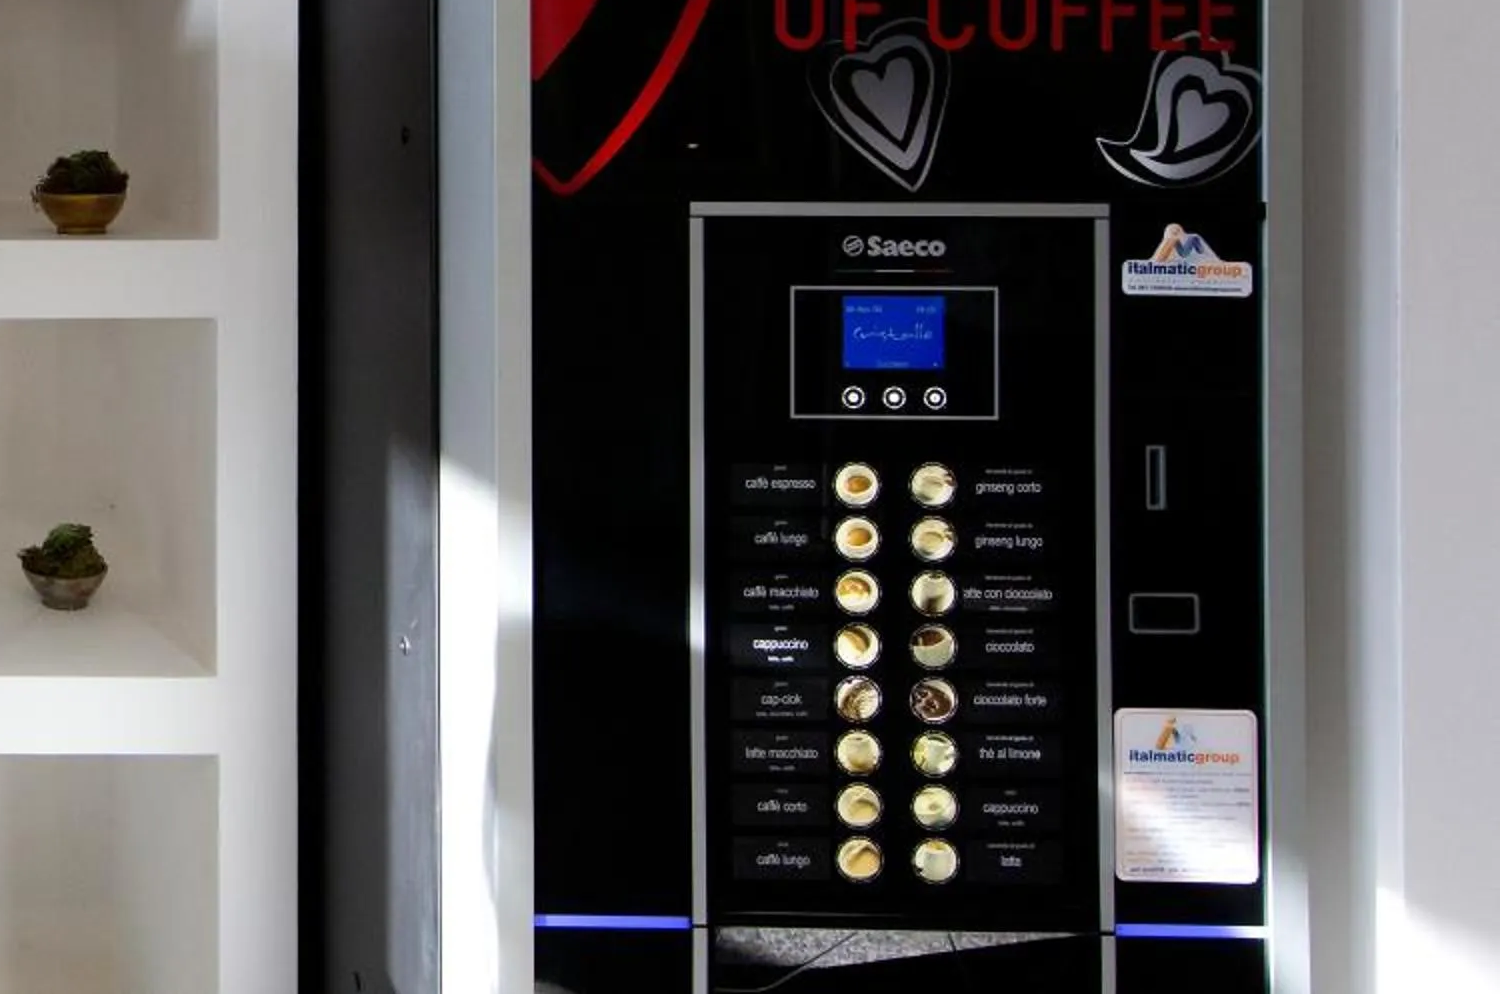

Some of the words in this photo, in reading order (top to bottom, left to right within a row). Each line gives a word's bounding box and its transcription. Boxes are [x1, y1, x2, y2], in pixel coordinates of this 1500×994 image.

[867, 235, 947, 257] Saeco
[1127, 261, 1242, 279] italmaticgroup
[745, 476, 769, 489] caffè
[771, 479, 816, 491] espresso
[975, 481, 1015, 495] ginseng
[1016, 481, 1043, 493] corto
[754, 531, 779, 545] caffè
[780, 532, 808, 547] lungo
[974, 535, 1014, 549] ginseng
[1015, 535, 1044, 549] lungo
[743, 585, 767, 598] caffè
[962, 587, 982, 599] atte
[984, 589, 1003, 599] con
[752, 638, 809, 653] cappuccino
[985, 640, 1035, 653] cioccolato
[1024, 693, 1047, 706] forte
[745, 746, 767, 759] latte
[997, 747, 1007, 759] al
[1008, 747, 1041, 760] limone
[1129, 749, 1240, 765] italmaticgroup
[756, 799, 781, 813] caffè
[982, 801, 1039, 815] cappuccino
[756, 854, 780, 866] caffè
[782, 854, 811, 869] lungo
[1000, 856, 1023, 868] latte
